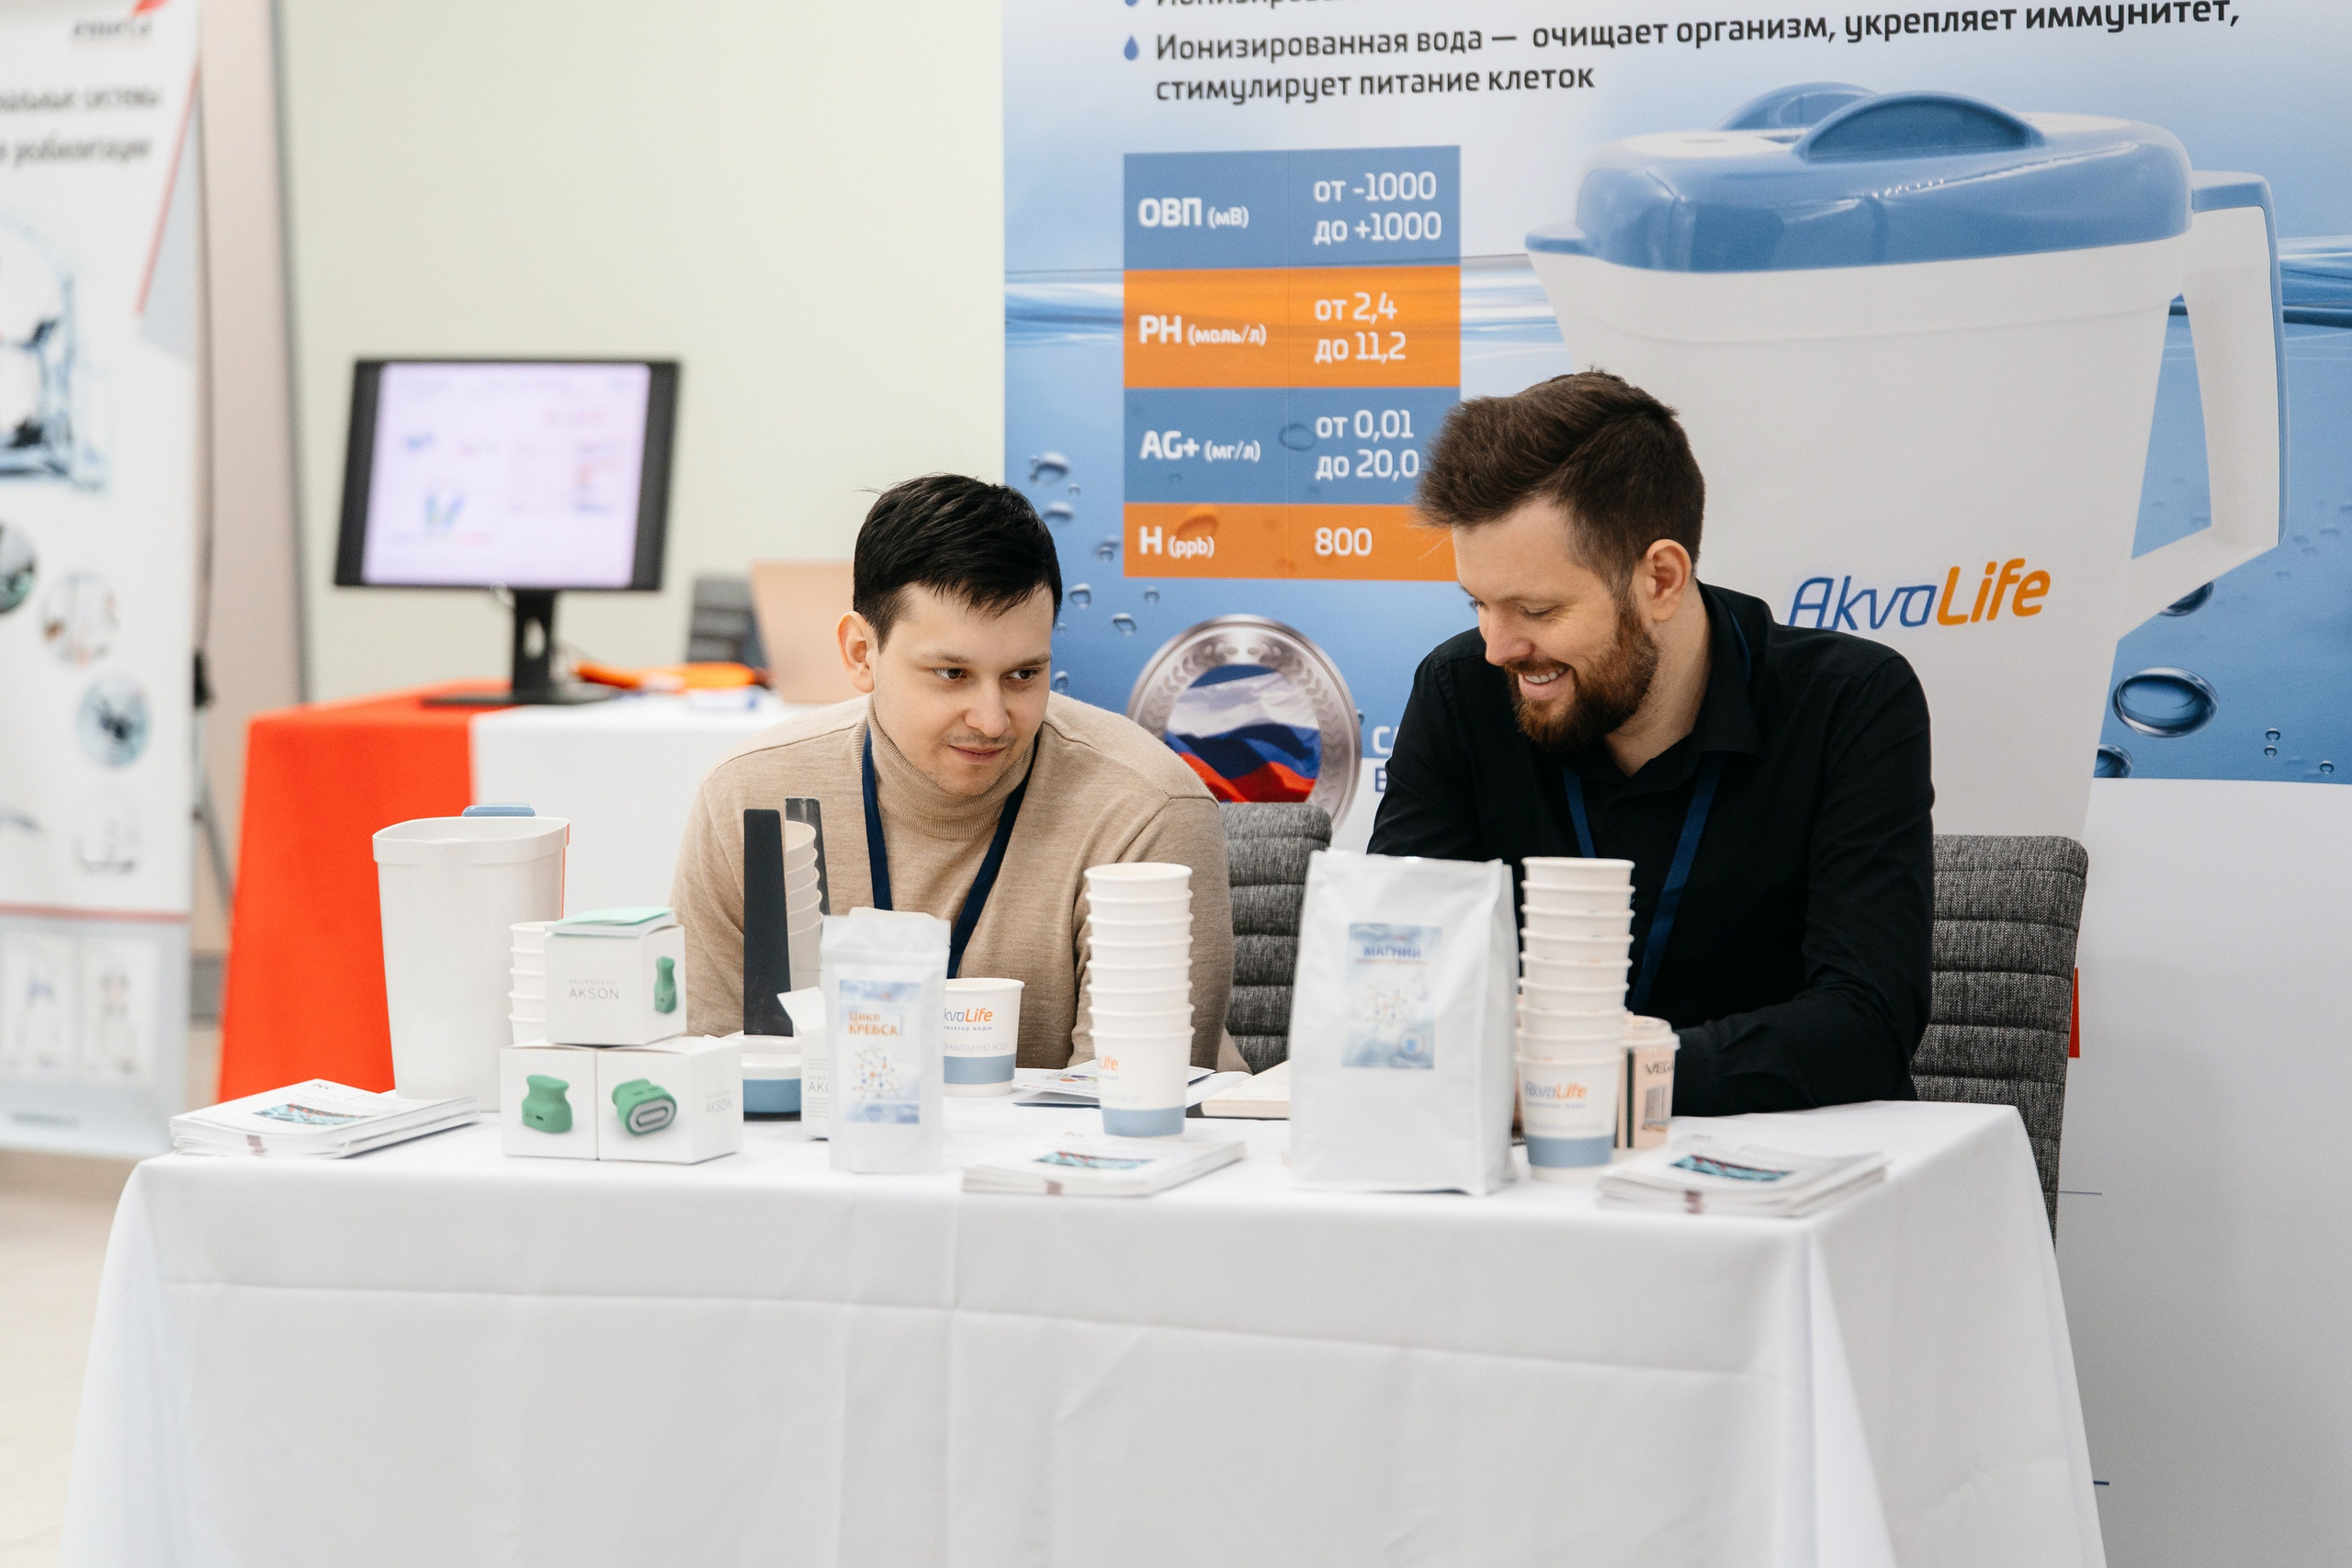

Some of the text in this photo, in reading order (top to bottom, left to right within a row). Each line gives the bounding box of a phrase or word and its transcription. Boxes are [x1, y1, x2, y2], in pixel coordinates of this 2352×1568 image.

[1157, 33, 1408, 63] Ионизированная
[1417, 29, 1483, 54] вода
[1532, 22, 1668, 49] очищает
[1677, 16, 1836, 50] организм,
[1845, 7, 2017, 43] укрепляет
[2025, 0, 2239, 33] иммунитет,
[1156, 67, 1595, 106] стимулирует питание клеток
[1314, 172, 1437, 202] от -1000
[1137, 197, 1250, 228] ОВП (мВ)
[1313, 211, 1442, 245] до +1000
[1314, 292, 1397, 324] от 2,4
[1138, 314, 1267, 345] PH (моль/л)
[1314, 332, 1407, 364] до 11,2
[1315, 410, 1415, 443] от 0,01
[1140, 430, 1261, 462] AG+ (мг/л)
[1315, 449, 1420, 482] до 20,0
[1138, 525, 1215, 558] H (ppb)
[1314, 527, 1374, 557] 800
[1788, 558, 2052, 631] AkvaLife
[569, 987, 619, 1000] AKSON
[849, 1010, 880, 1022] Цикл
[849, 1023, 899, 1036] КРЕБСА
[944, 1008, 993, 1021] kvaLife
